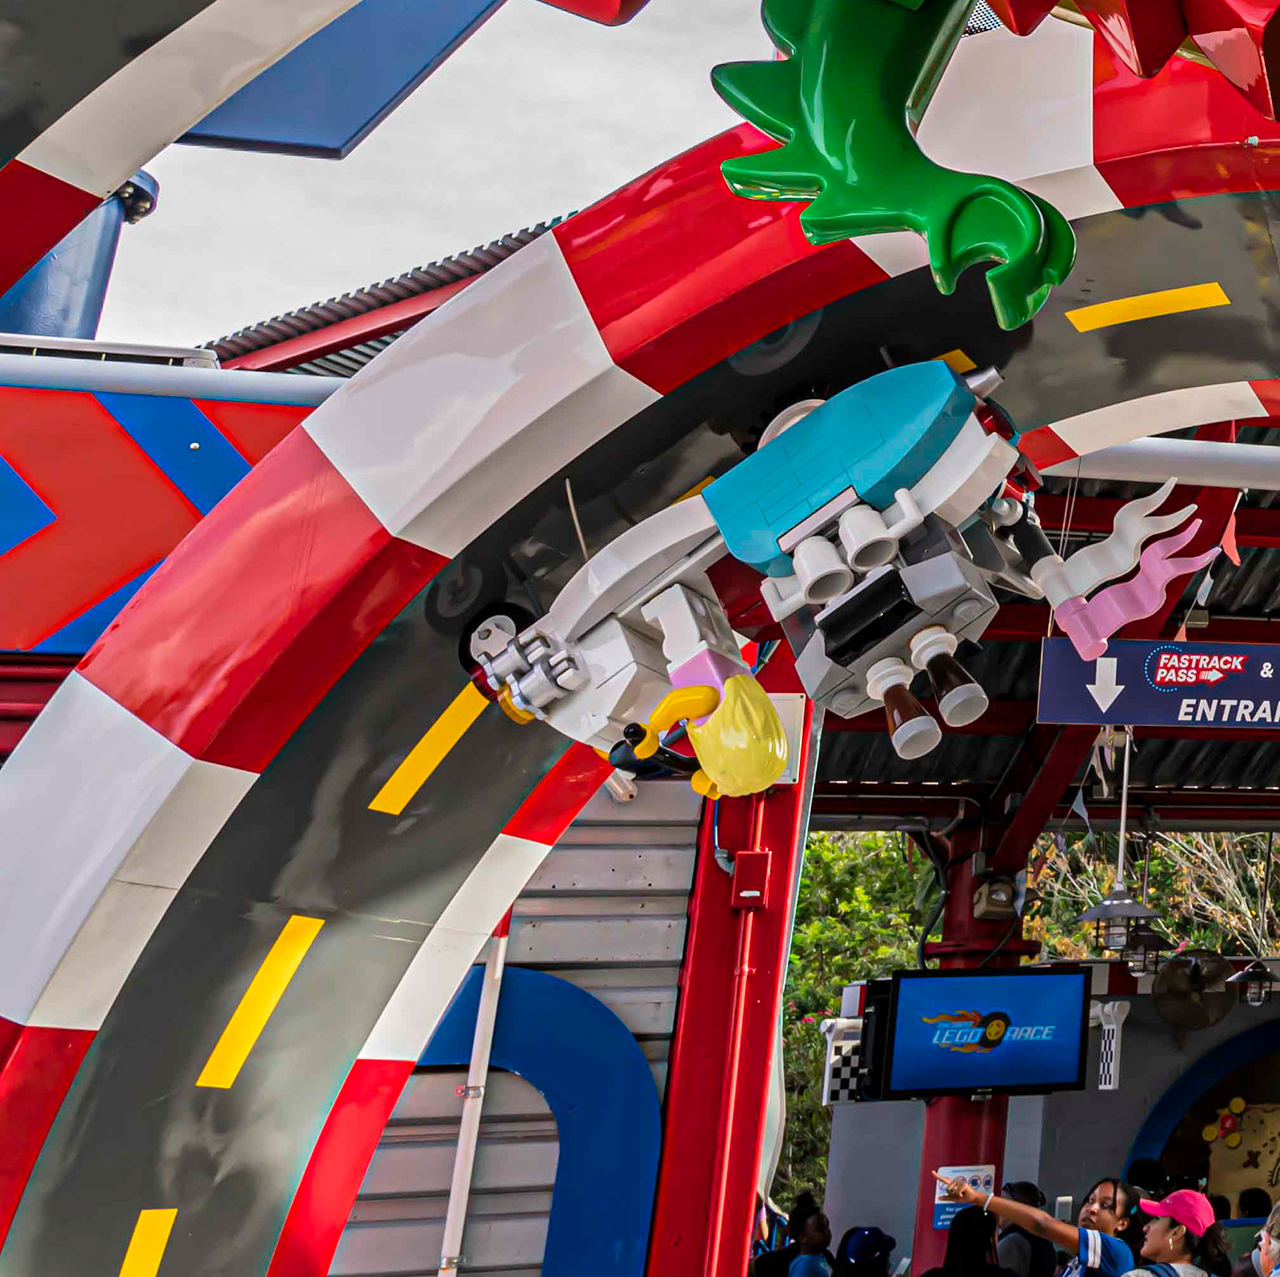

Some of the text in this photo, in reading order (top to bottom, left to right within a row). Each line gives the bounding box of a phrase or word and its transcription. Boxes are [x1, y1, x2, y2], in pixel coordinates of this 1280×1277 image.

[1159, 654, 1244, 670] FASTRACK
[1156, 669, 1197, 682] PASS
[1259, 662, 1275, 679] &
[932, 1028, 986, 1044] LEGO
